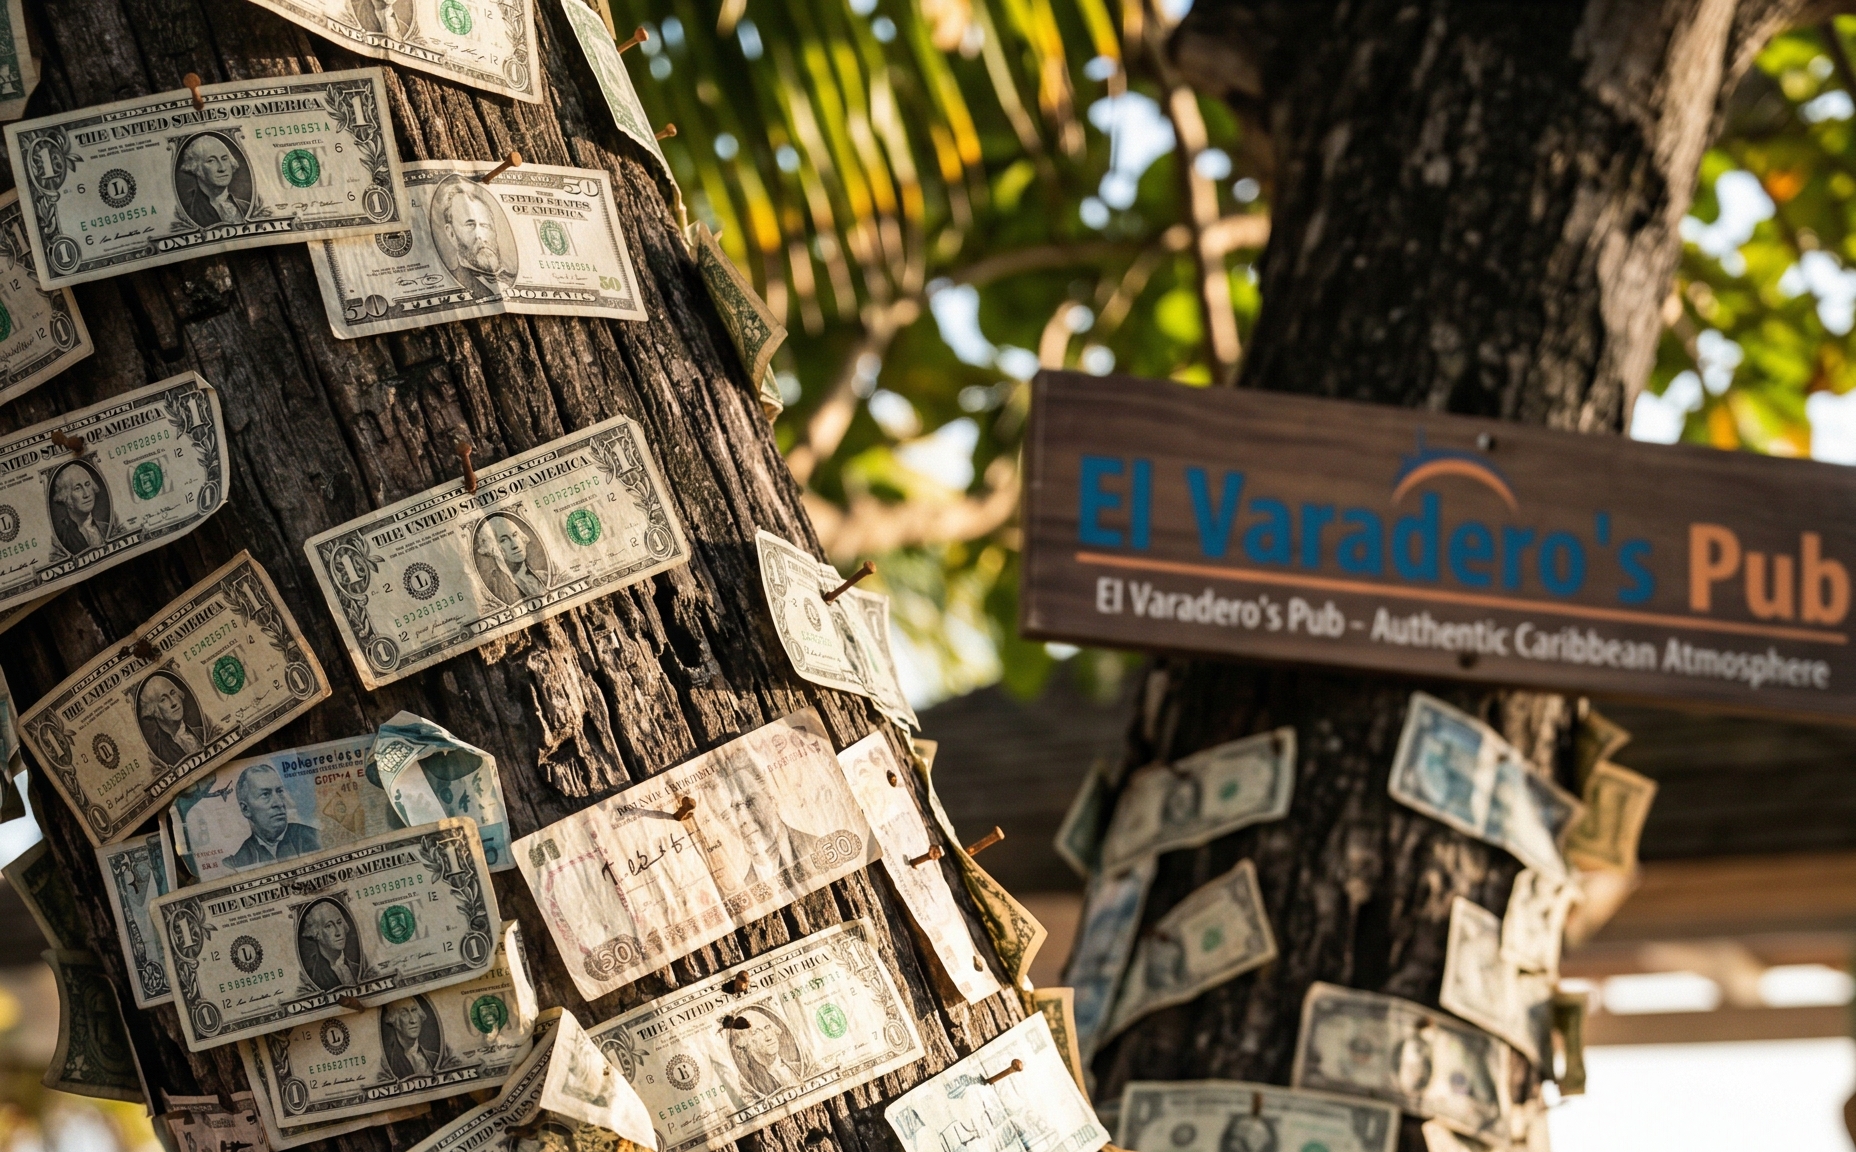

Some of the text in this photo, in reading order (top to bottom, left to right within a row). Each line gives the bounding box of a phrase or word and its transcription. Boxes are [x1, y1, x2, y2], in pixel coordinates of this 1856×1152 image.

[75, 128, 109, 147] THE
[251, 97, 323, 115] AMERICA
[335, 143, 343, 153] 6
[77, 184, 85, 194] 6
[111, 181, 125, 197] L
[347, 191, 355, 201] 6
[563, 178, 599, 197] 50
[85, 235, 94, 245] 6
[158, 219, 291, 251] ONE DOLLAR
[9, 278, 21, 292] 12
[599, 275, 621, 292] 50
[346, 294, 389, 321] 50
[35, 327, 47, 341] 12
[104, 407, 163, 436] AMERICA
[174, 447, 184, 458] 12
[528, 454, 590, 488] AMERICA
[185, 492, 195, 504] 12
[1078, 454, 1851, 626] El Varadero's Pub
[415, 571, 429, 589] L
[1097, 577, 1126, 614] El
[1130, 581, 1283, 634] Varadero's
[1287, 593, 1345, 641] Pub
[1371, 605, 1510, 657] Authentic
[1514, 622, 1658, 671] Caribbean
[1662, 637, 1830, 690] Atmosphere
[208, 898, 240, 916] THE
[357, 851, 418, 877] AMERICA
[211, 951, 221, 962] 12
[222, 998, 232, 1009] 12
[367, 1068, 478, 1100] ONE DOLLAR
